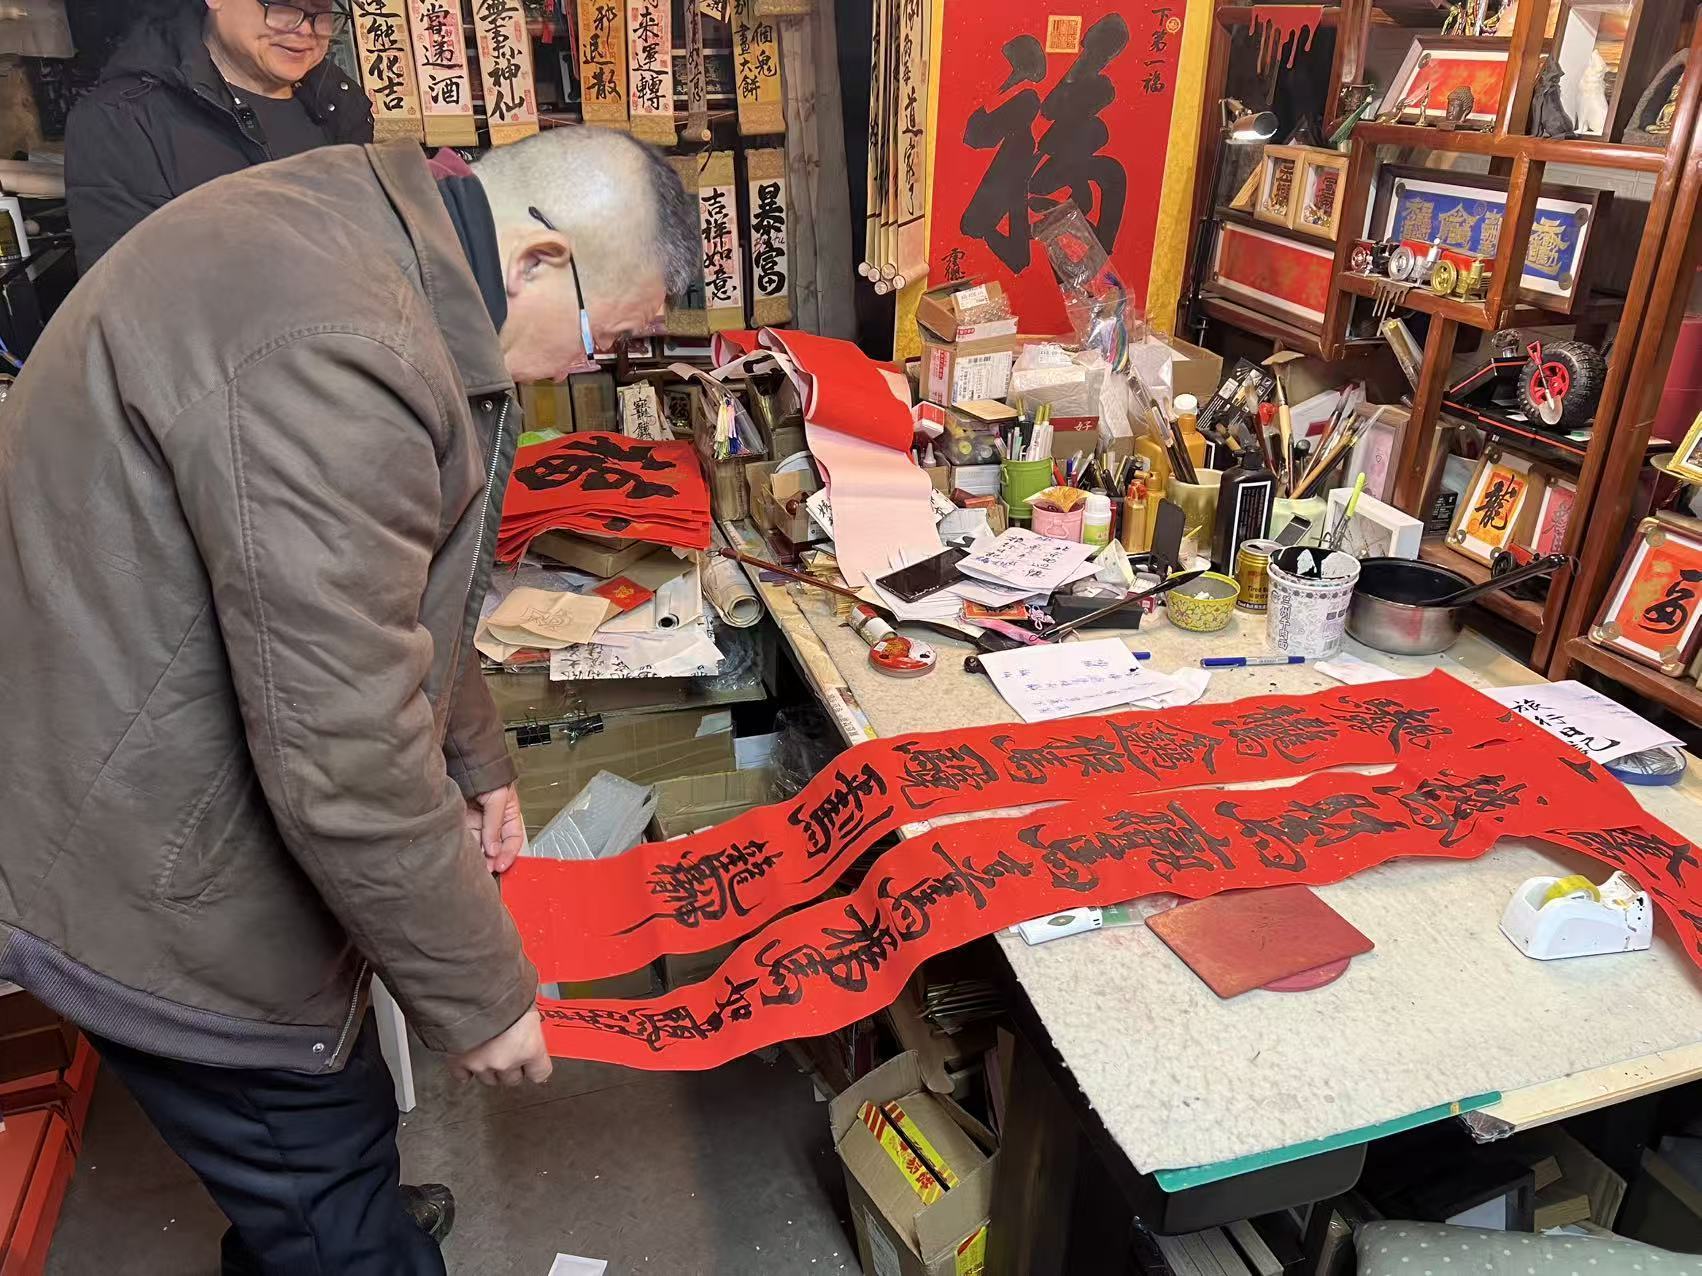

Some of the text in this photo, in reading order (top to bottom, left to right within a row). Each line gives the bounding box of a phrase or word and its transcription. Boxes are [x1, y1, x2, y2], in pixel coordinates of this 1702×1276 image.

[582, 0, 622, 101] 邪退散
[960, 12, 1130, 276] 福
[701, 187, 737, 301] 吉祥如意
